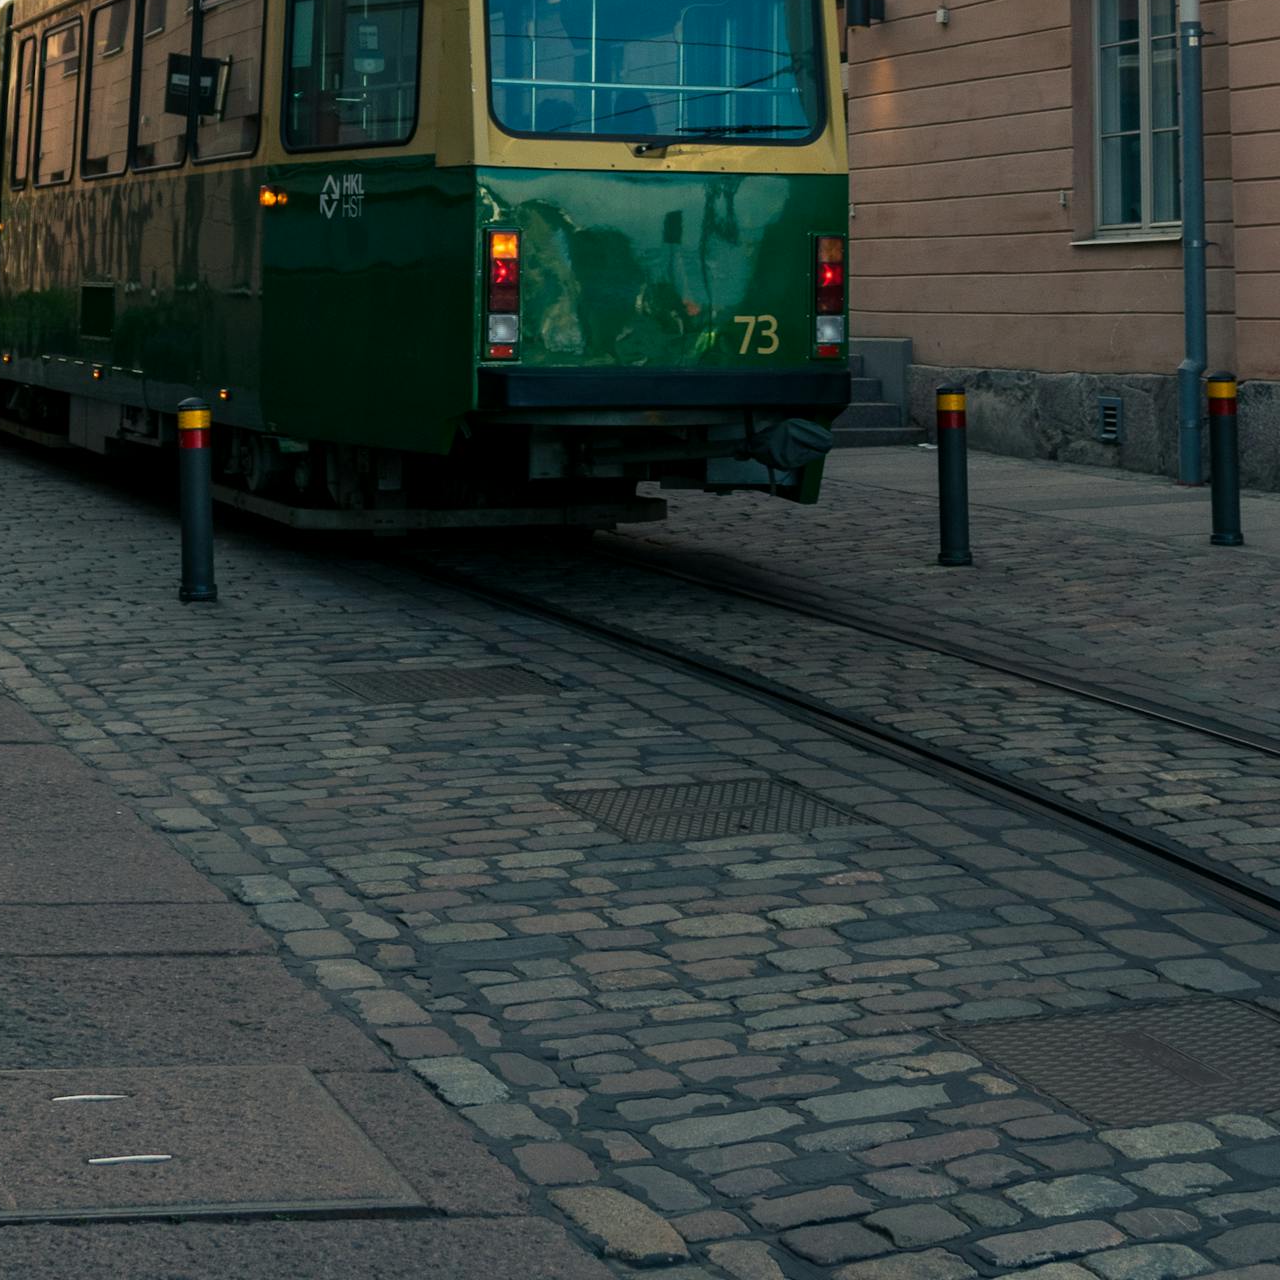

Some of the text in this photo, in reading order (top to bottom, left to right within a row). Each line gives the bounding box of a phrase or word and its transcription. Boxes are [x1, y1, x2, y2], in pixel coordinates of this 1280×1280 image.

[342, 173, 365, 195] HKL
[341, 195, 365, 218] HST
[733, 314, 780, 355] 73
